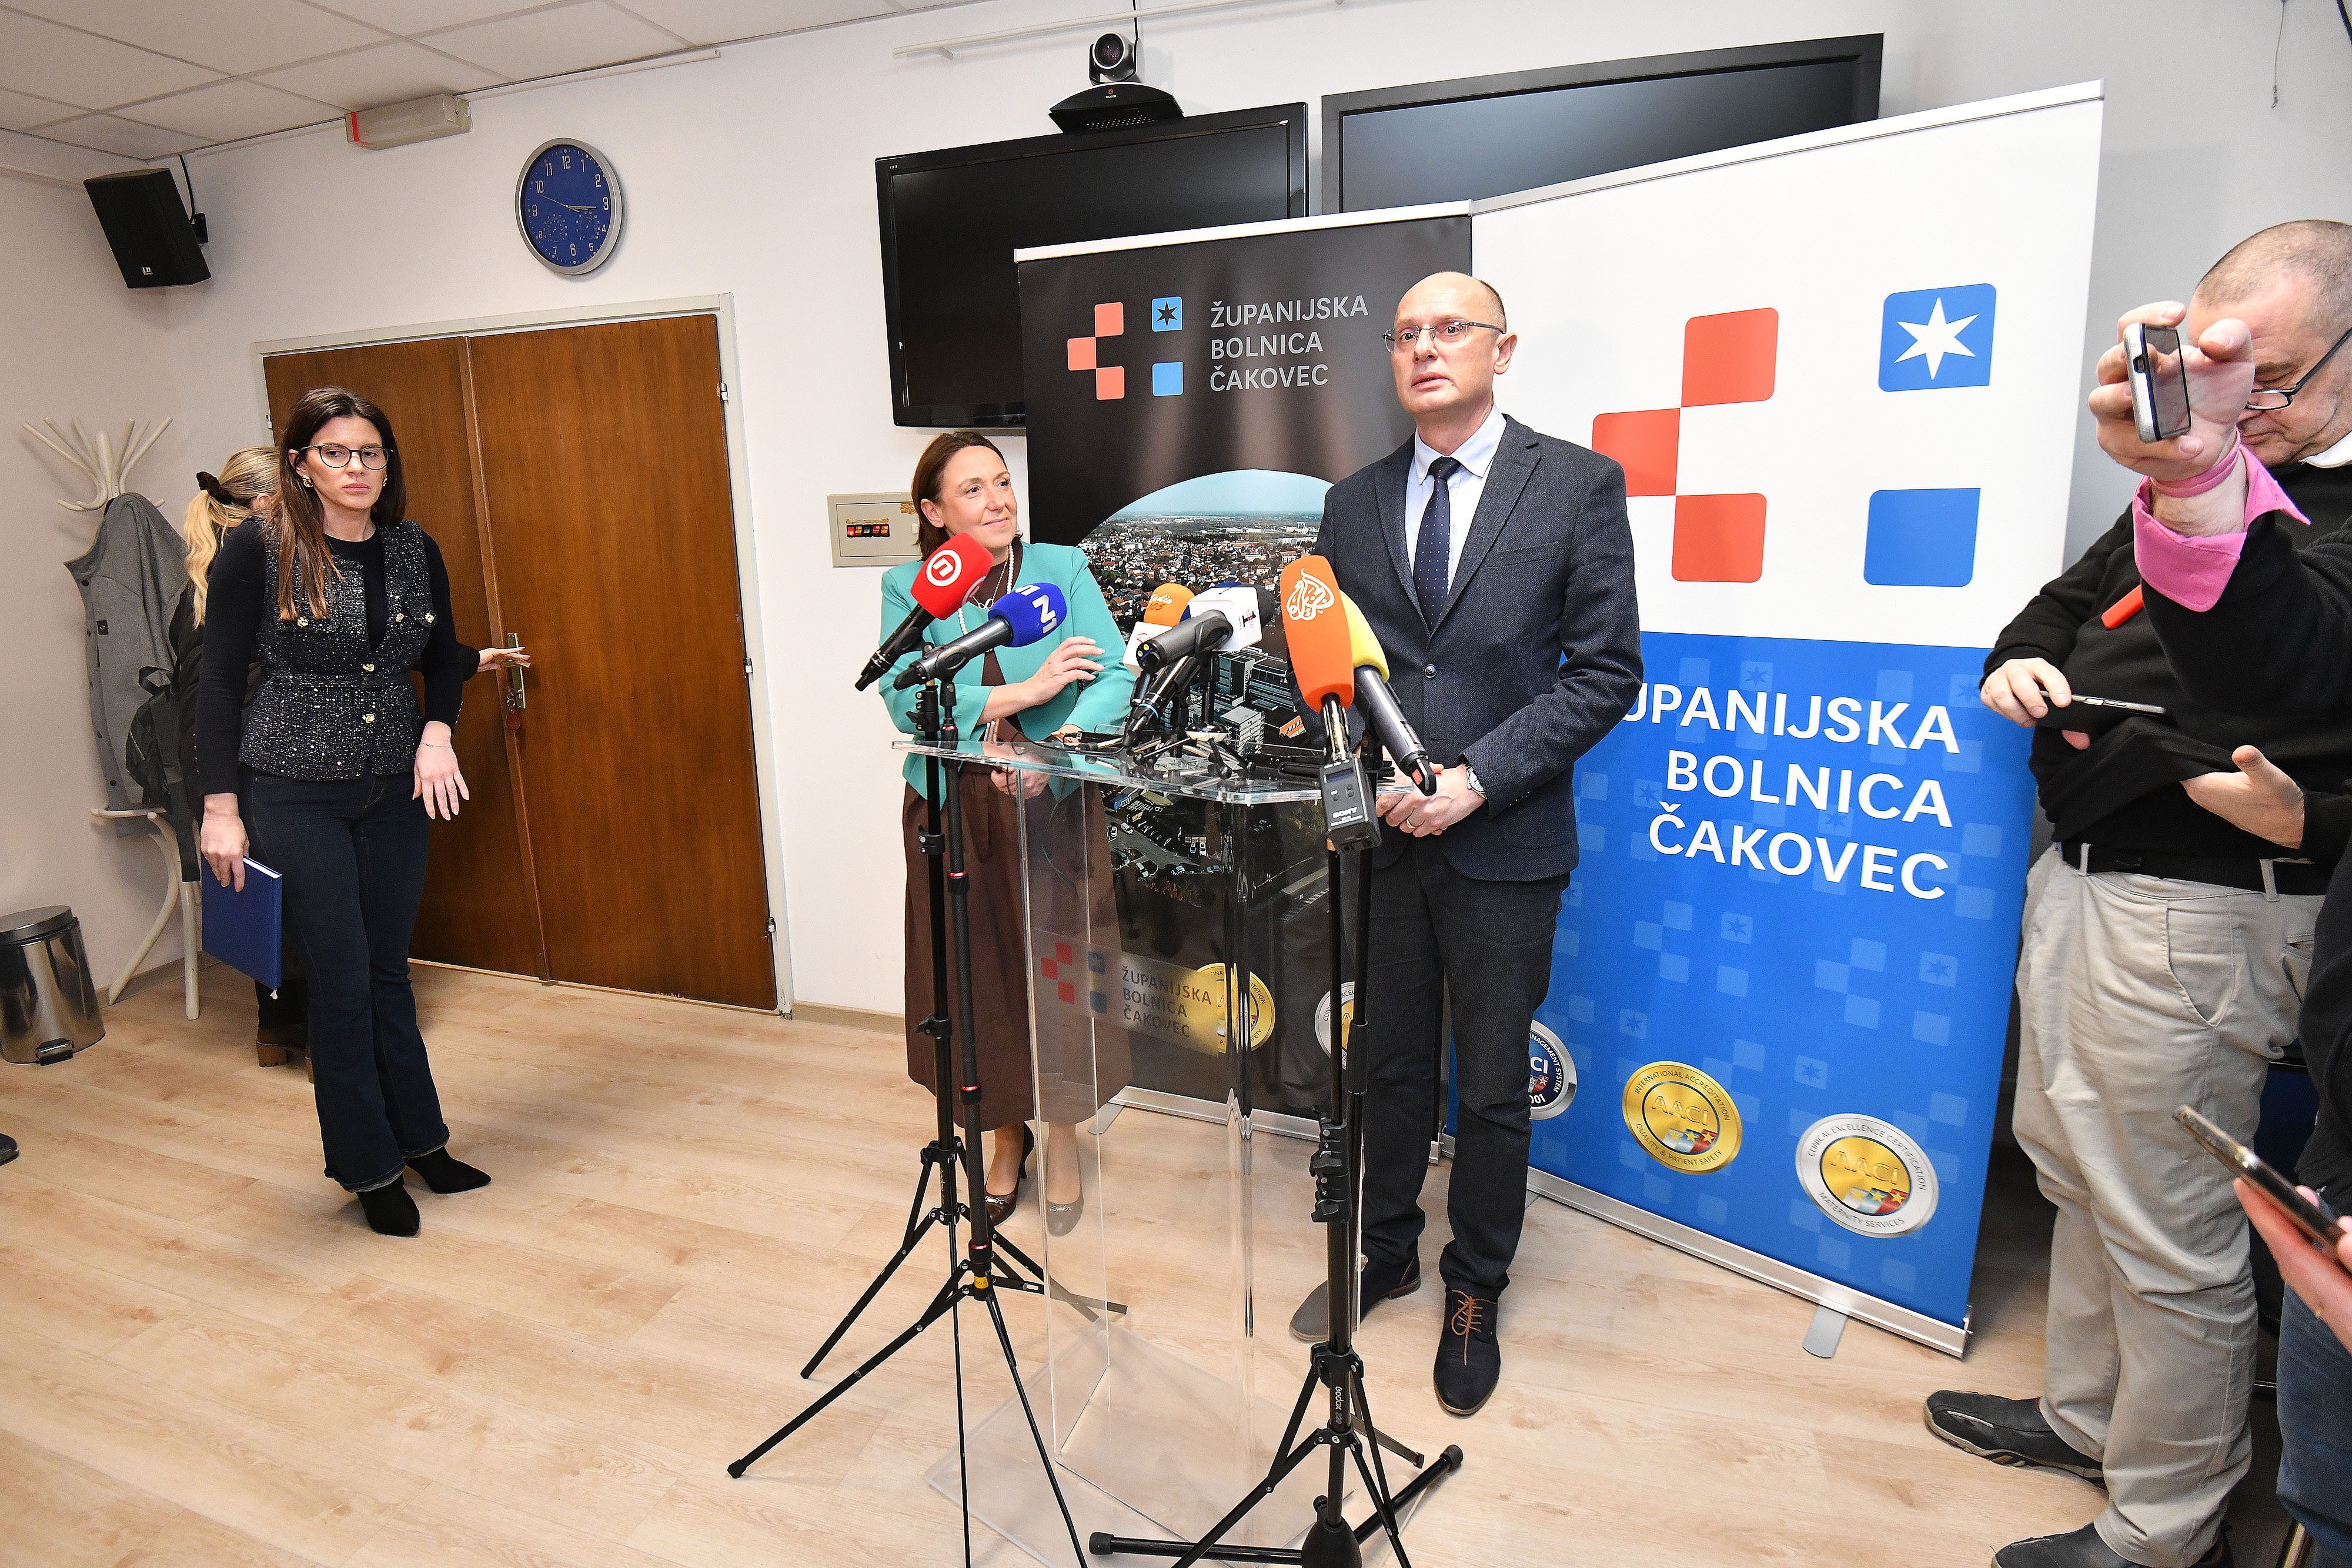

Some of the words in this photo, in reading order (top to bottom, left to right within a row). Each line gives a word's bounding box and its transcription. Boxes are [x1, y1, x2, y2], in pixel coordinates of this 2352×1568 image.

[545, 162, 553, 176] 11
[562, 155, 571, 169] 12
[581, 159, 585, 173] 1
[536, 180, 544, 193] 10
[595, 173, 602, 188] 2
[532, 204, 538, 217] 9
[603, 197, 609, 210] 3
[538, 230, 543, 239] 8
[602, 224, 607, 233] 4
[553, 246, 557, 255] 7
[570, 243, 576, 256] 6
[589, 243, 594, 252] 5
[1211, 295, 1368, 328] ŽUPANIJSKA
[1211, 332, 1323, 360] BOLNICA
[1210, 363, 1328, 392] ČAKOVEC
[1622, 682, 1960, 754] UPANIJSKA
[1666, 750, 1953, 828] BOLNICA
[1649, 801, 1949, 900] ČAKOVEC
[1122, 965, 1212, 1005] ŽUPANIJSKA
[1123, 988, 1187, 1018] BOLNICA
[1124, 1004, 1190, 1038] ČAKOVEC
[1553, 1068, 1562, 1093] SYSTEM
[1634, 1070, 1683, 1094] INTERNATIONAL
[1685, 1074, 1730, 1121] ACCREDITATION
[1652, 1095, 1708, 1126] AACI
[1636, 1123, 1659, 1150] QUALITY
[1668, 1154, 1698, 1166] PATIENT
[1700, 1149, 1723, 1165] SAFETY
[1808, 1130, 1831, 1157] CLINICAL
[1832, 1124, 1885, 1138] EXCELLENCE
[1886, 1134, 1927, 1191] CERTIFICATION
[1830, 1151, 1899, 1185] AACI
[1819, 1192, 1863, 1224] MATERNITY
[1865, 1217, 1905, 1228] SERVICES
[1335, 1386, 1344, 1410] Godox
